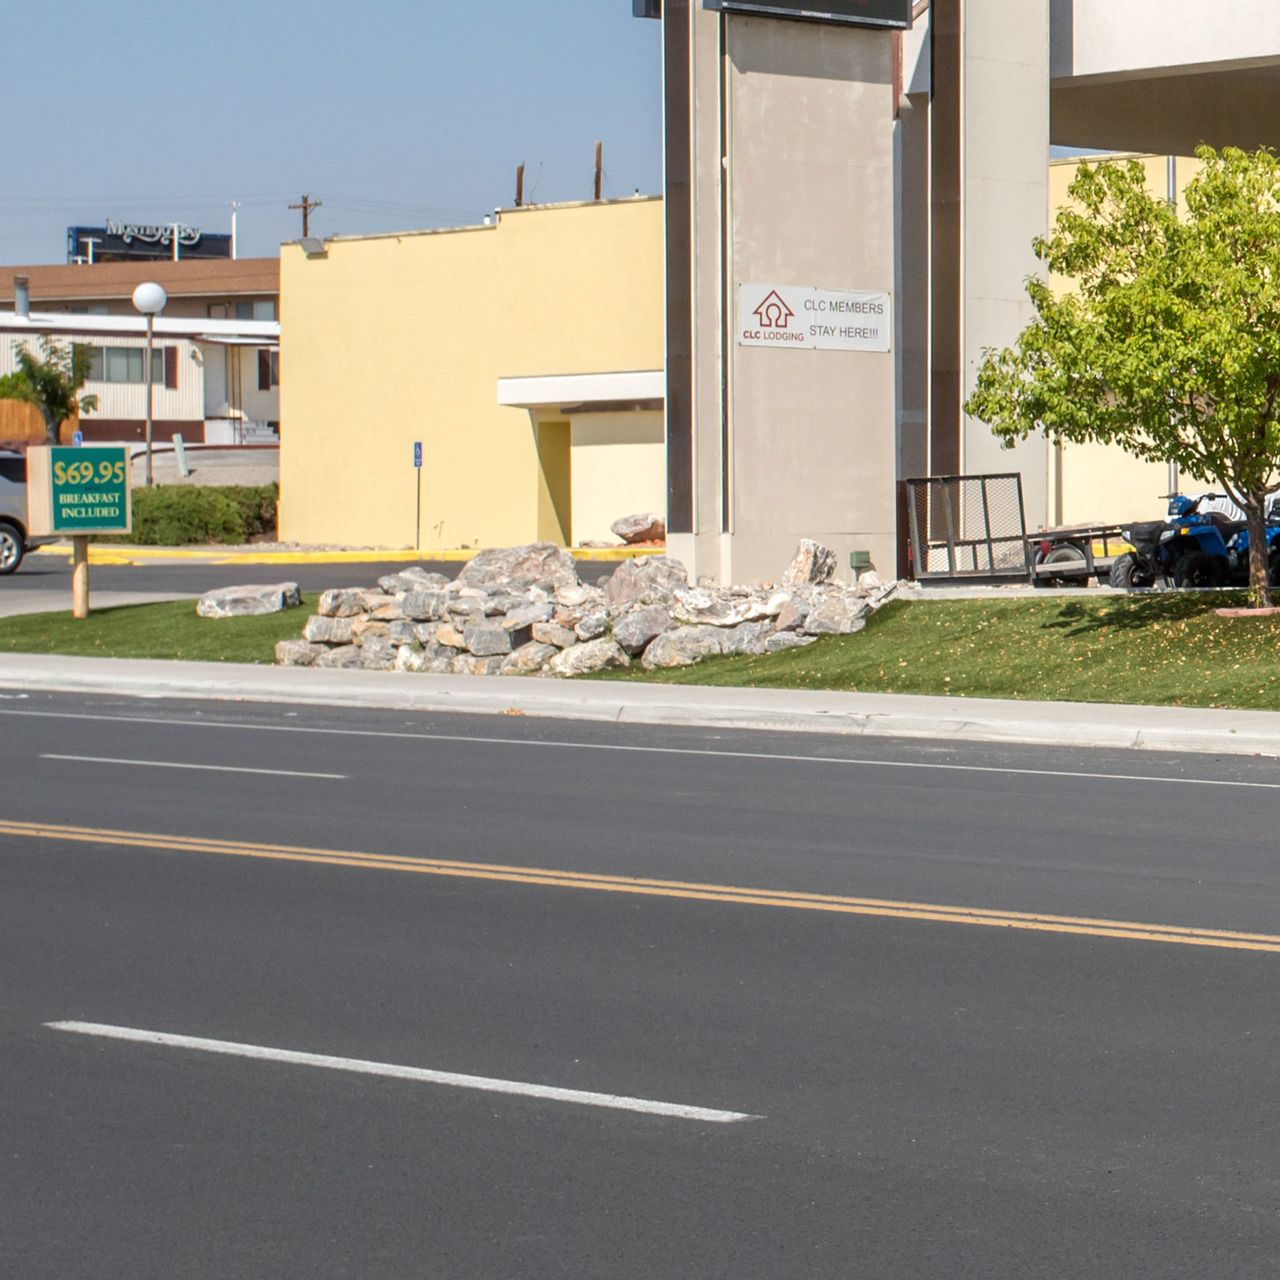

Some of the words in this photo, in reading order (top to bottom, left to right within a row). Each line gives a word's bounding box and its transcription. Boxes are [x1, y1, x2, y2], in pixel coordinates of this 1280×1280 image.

[804, 299, 826, 312] CLC
[829, 301, 884, 315] MEMBERS
[743, 330, 761, 340] CLC
[763, 331, 804, 342] LODGING
[809, 325, 836, 338] STAY
[839, 326, 878, 339] HERE!!!
[54, 461, 125, 487] $69.95
[59, 493, 120, 505] BREAKFAST
[61, 507, 119, 519] INCLUDED
